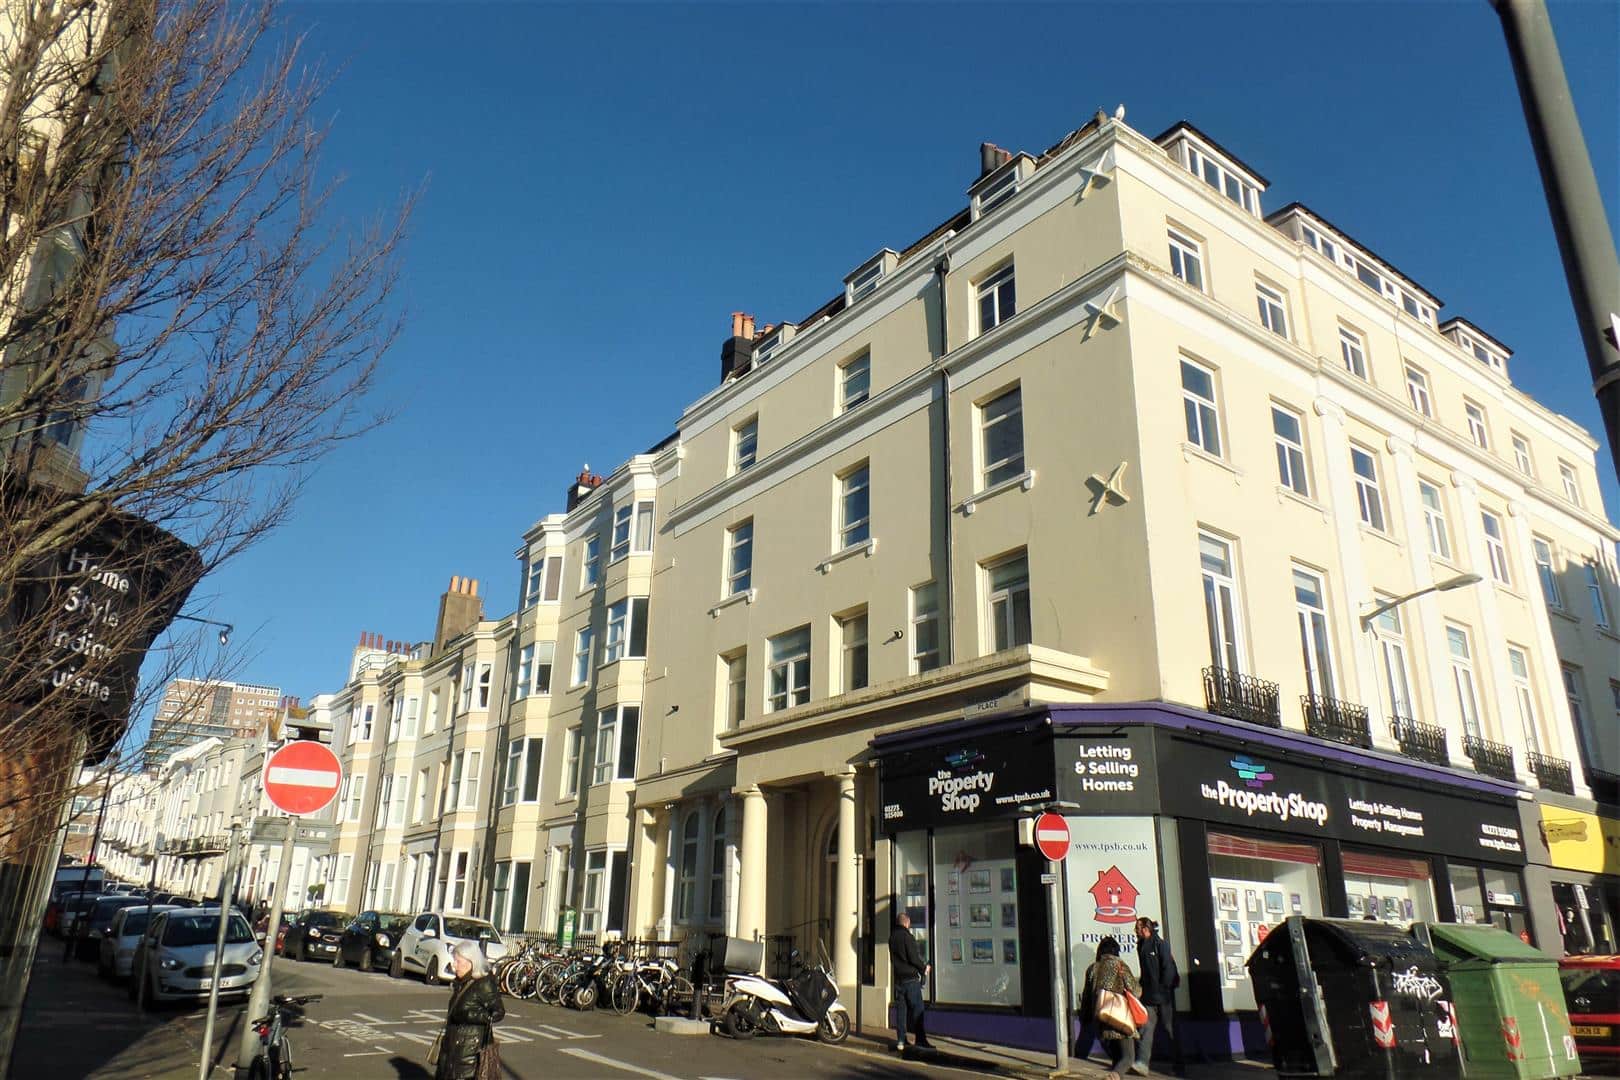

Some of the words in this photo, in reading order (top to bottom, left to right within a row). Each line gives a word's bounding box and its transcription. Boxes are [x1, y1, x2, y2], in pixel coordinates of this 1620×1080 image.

[67, 548, 130, 593] Home
[1079, 744, 1132, 760] Letting
[937, 770, 951, 780] the
[1075, 761, 1086, 774] &
[1088, 761, 1139, 777] Selling
[928, 770, 994, 796] Property
[1082, 778, 1134, 791] Homes
[1201, 783, 1218, 800] the
[941, 793, 980, 813] Shop
